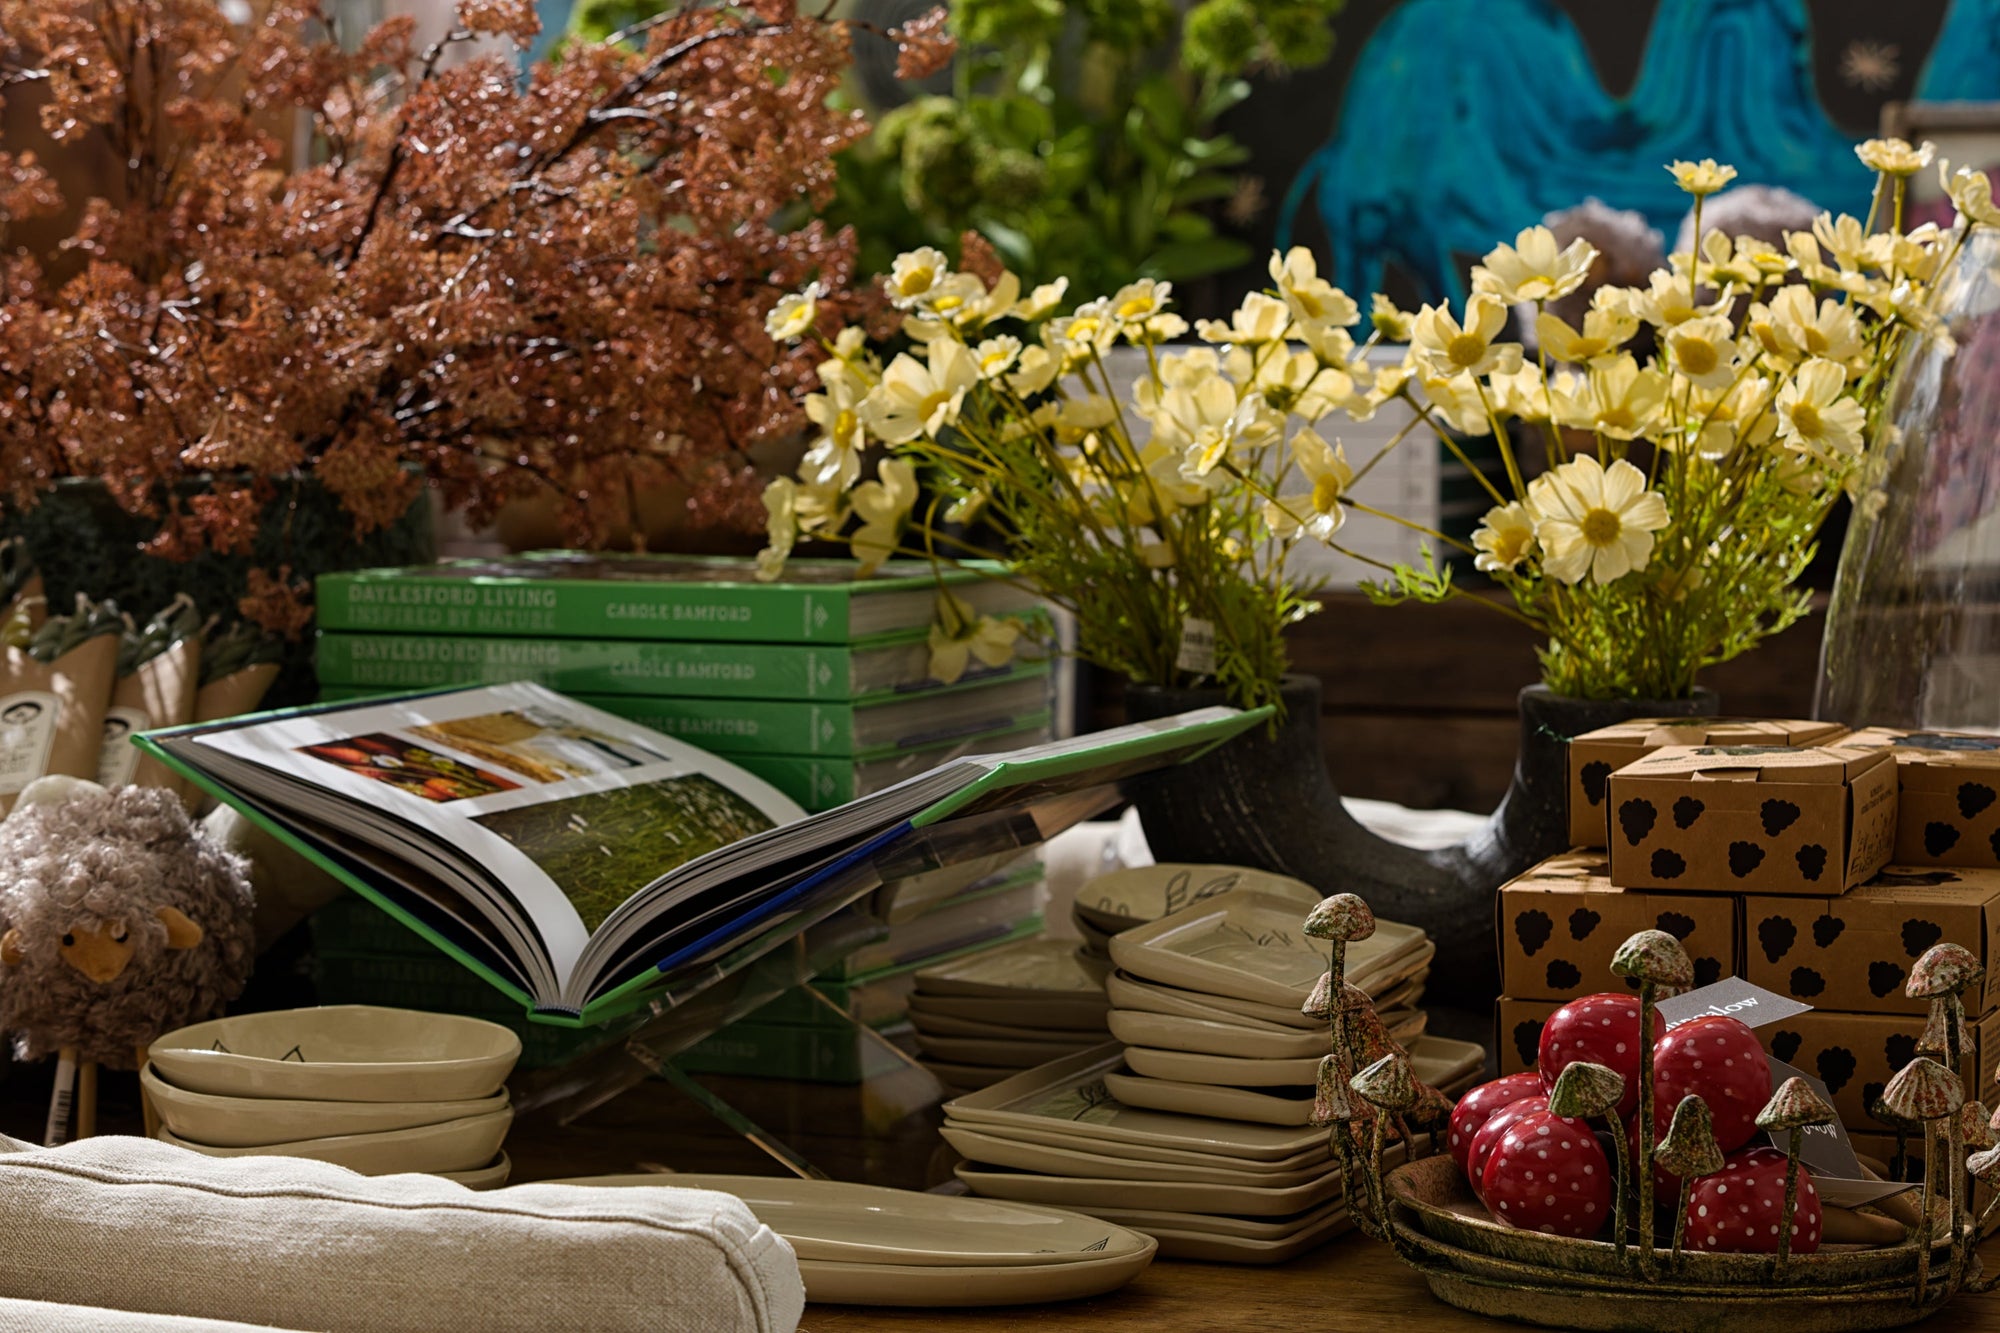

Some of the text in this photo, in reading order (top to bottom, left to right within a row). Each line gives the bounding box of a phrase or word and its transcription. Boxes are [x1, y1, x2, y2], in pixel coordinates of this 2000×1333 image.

[350, 584, 557, 608] DAYLESFORD LIVING
[350, 606, 555, 630] INSPIRED BY NATURE
[606, 603, 752, 622] CAROLE BAMFORD
[352, 640, 560, 664] DAYLESFORD LIVING
[610, 660, 755, 680] CAROLE BAMFORD
[680, 717, 759, 736] BAMFORD
